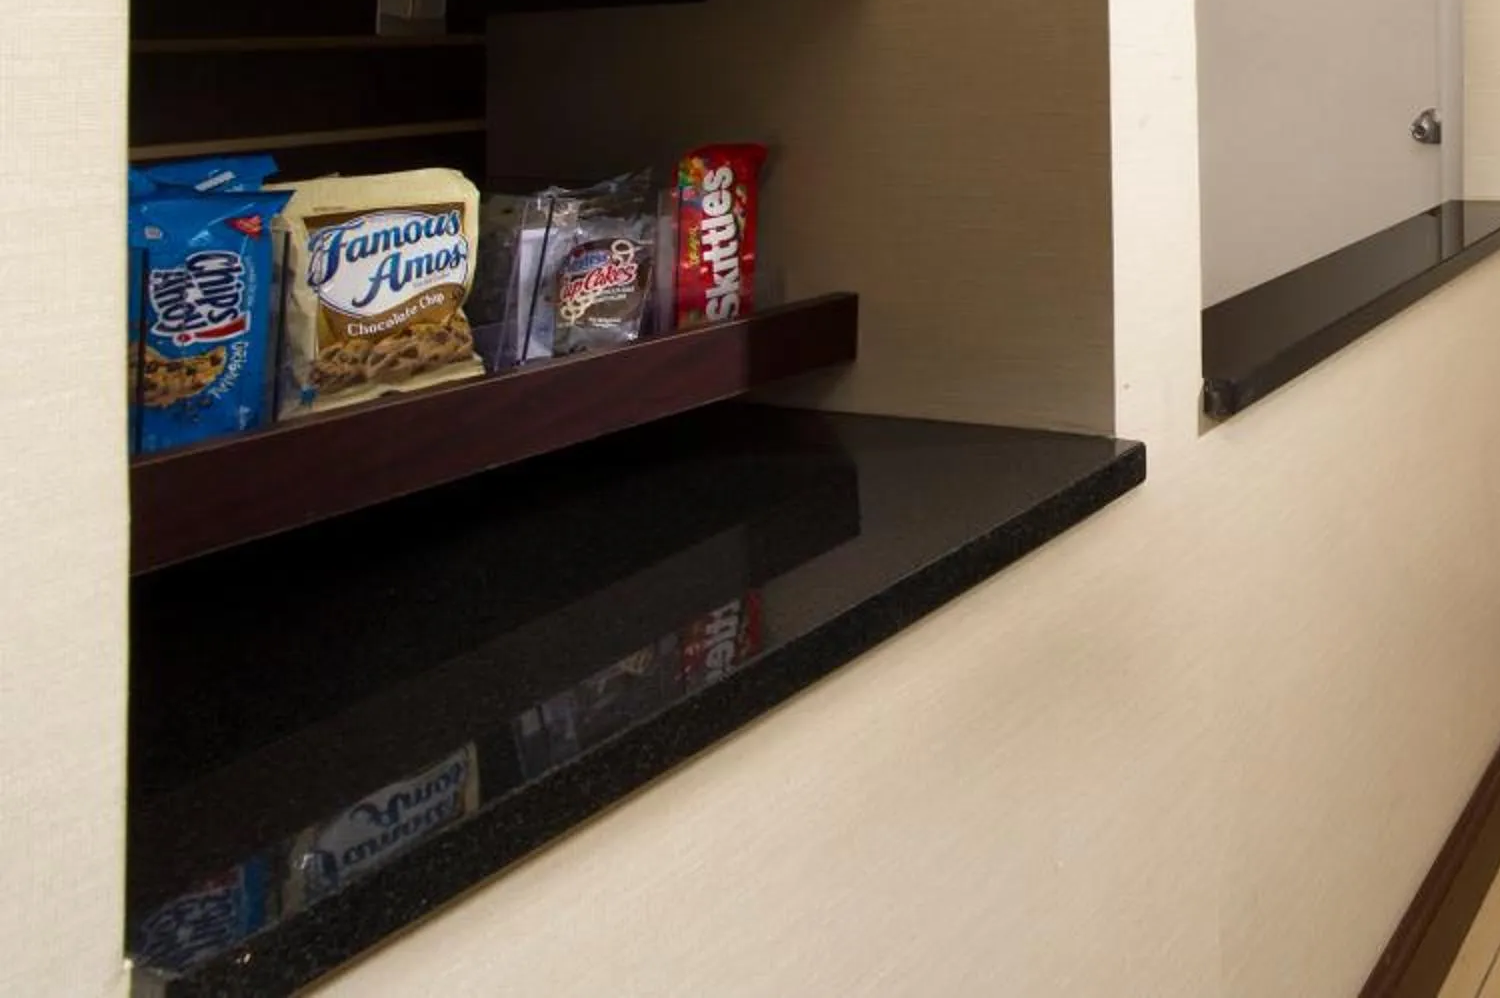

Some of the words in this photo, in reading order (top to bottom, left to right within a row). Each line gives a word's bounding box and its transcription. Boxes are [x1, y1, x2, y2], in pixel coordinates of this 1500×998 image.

[307, 209, 460, 288] Famous
[351, 242, 467, 309] Amos
[184, 251, 243, 325] Chips
[347, 308, 418, 337] Chocolate
[419, 291, 445, 311] Chip
